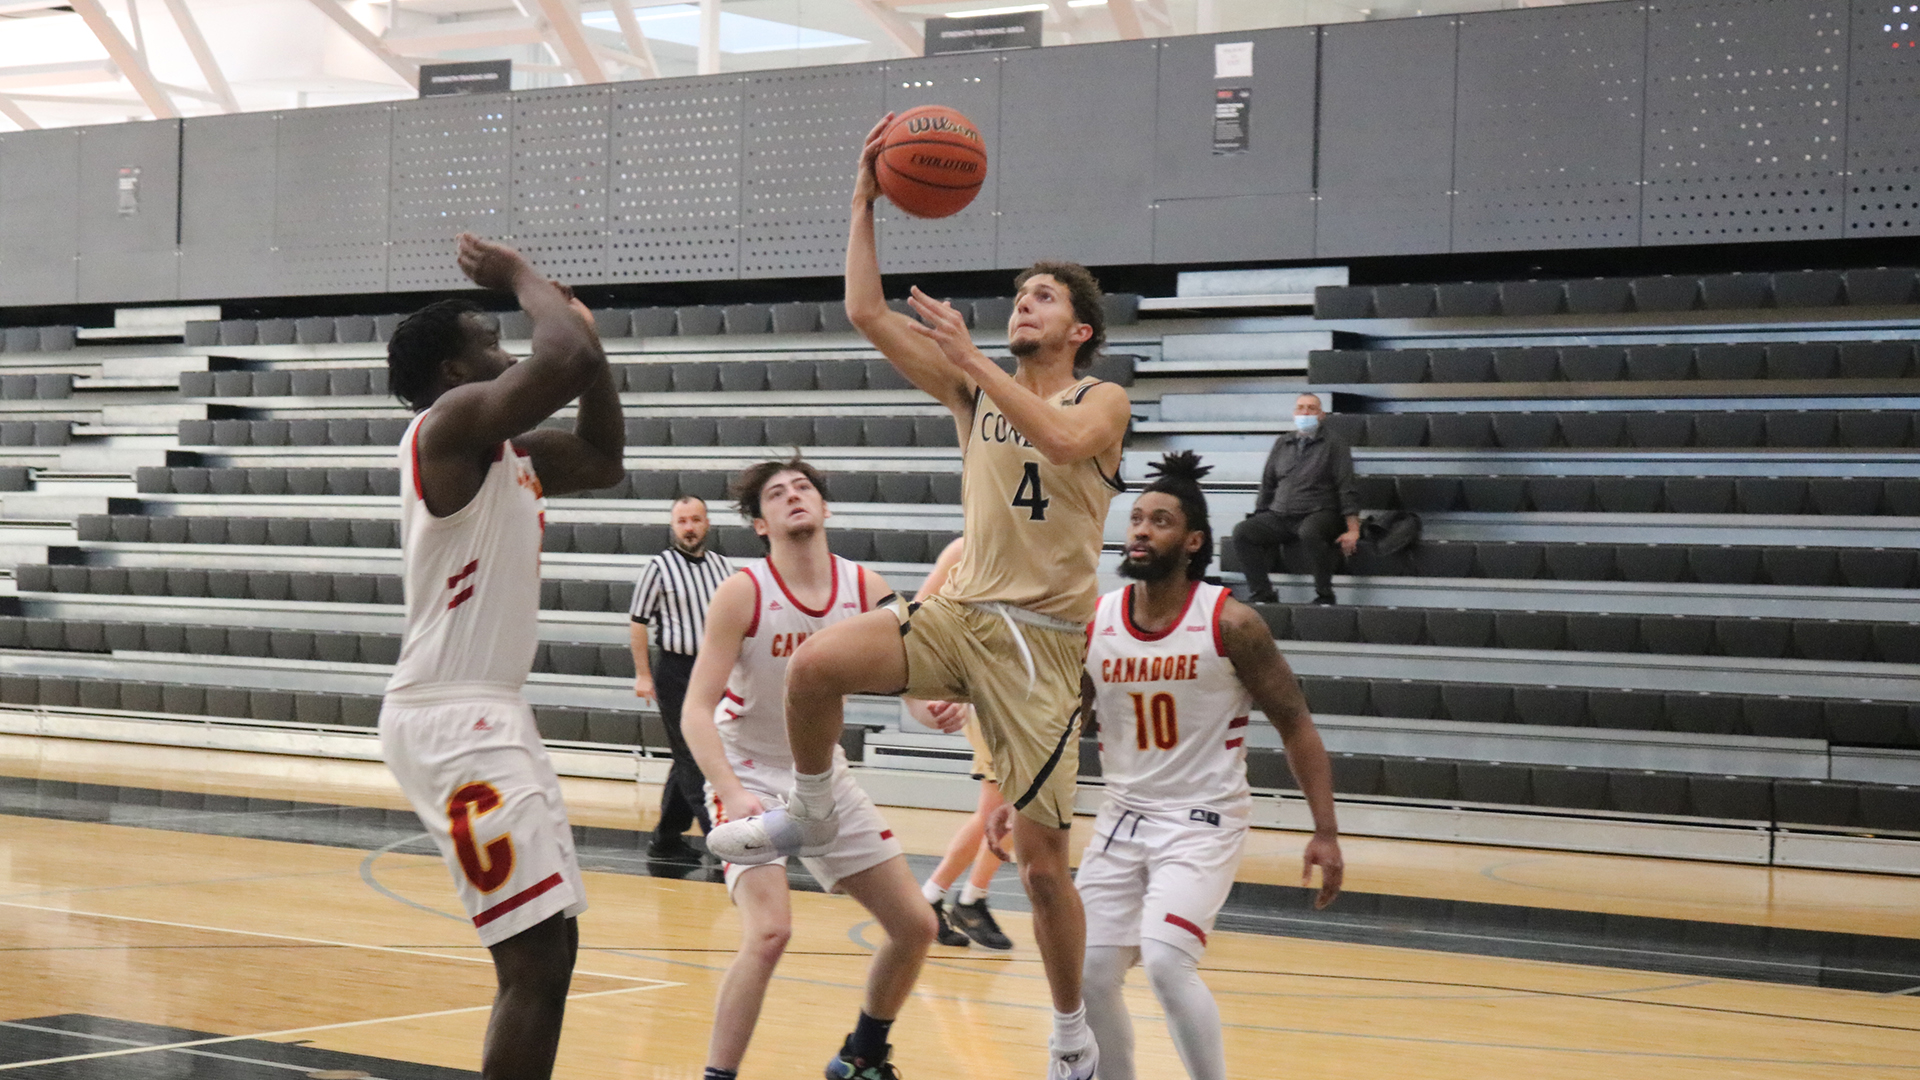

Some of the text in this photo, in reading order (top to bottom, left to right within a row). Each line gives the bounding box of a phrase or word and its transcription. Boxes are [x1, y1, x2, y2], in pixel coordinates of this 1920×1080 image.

[908, 117, 978, 142] Wilson
[981, 412, 1034, 447] CON
[1010, 461, 1050, 521] 4
[1102, 654, 1200, 683] CANADORE
[1128, 691, 1179, 751] 10
[447, 781, 516, 896] C
